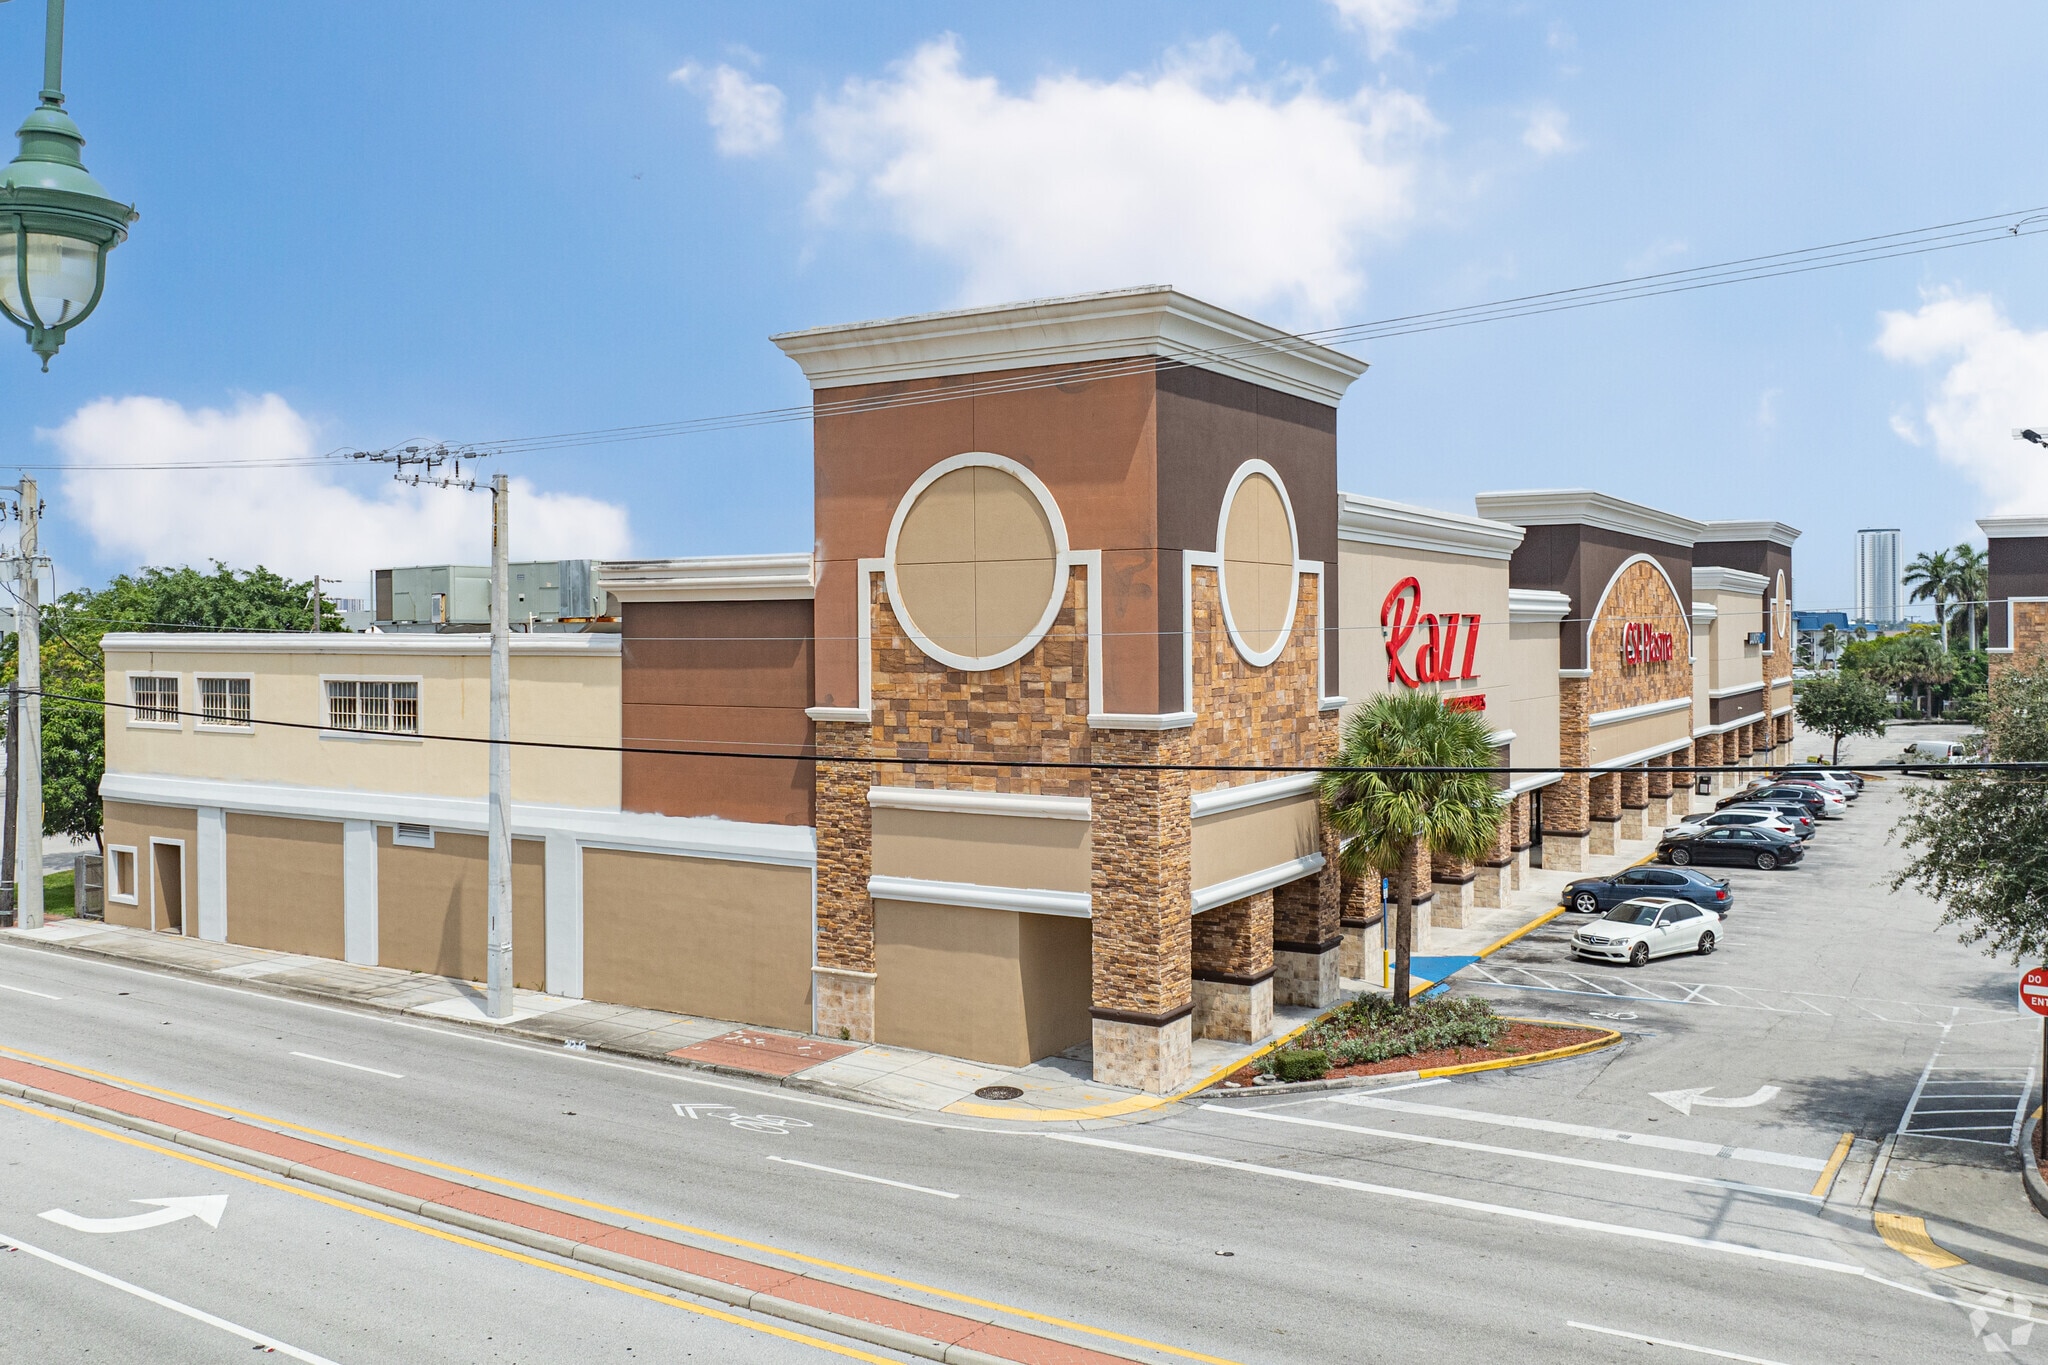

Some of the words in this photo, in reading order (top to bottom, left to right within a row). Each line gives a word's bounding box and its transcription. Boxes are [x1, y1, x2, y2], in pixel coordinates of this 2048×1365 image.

[1381, 576, 1481, 688] Razz
[1623, 622, 1642, 665] CSL
[1643, 623, 1672, 663] Plasma
[2028, 974, 2042, 984] DO
